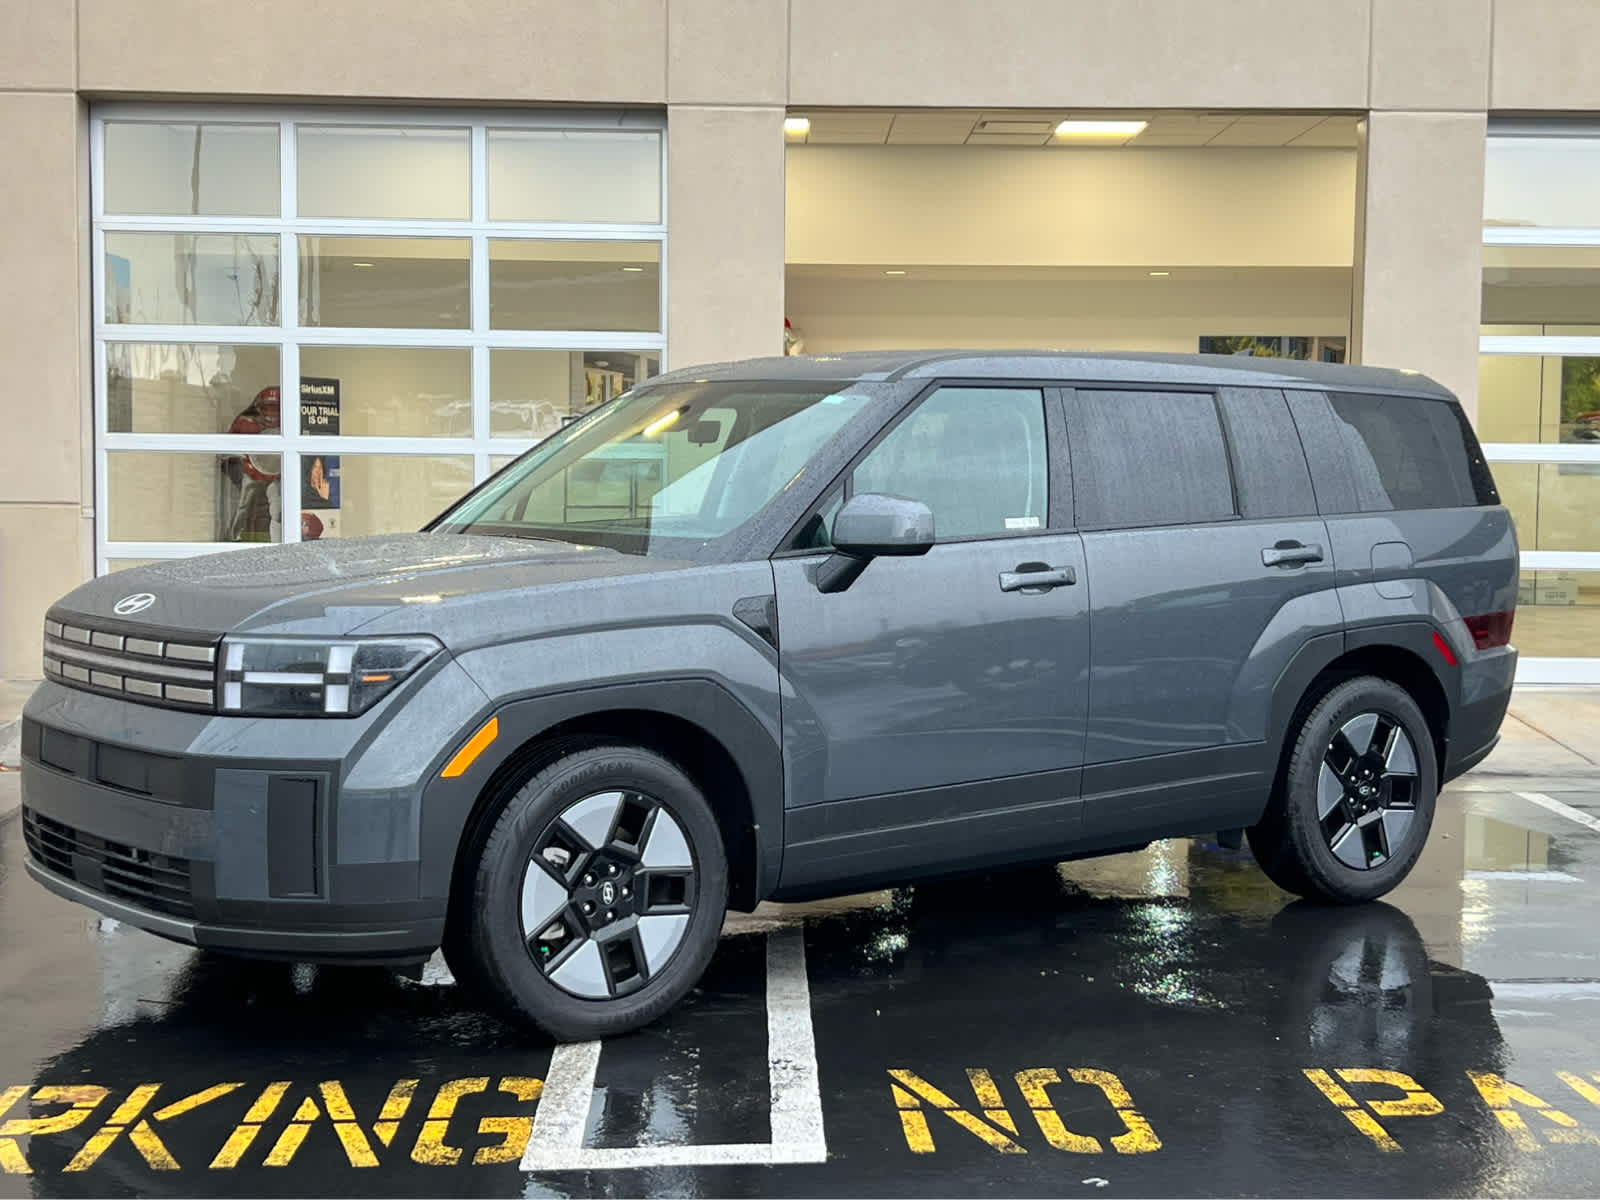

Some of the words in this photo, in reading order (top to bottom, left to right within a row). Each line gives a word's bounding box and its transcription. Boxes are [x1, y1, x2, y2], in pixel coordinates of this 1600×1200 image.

[301, 384, 335, 394] SiriusXM
[301, 406, 318, 415] OUR
[319, 407, 339, 416] TRIAL
[309, 416, 316, 424] IS
[317, 416, 328, 424] ON
[886, 1067, 1163, 1155] NO
